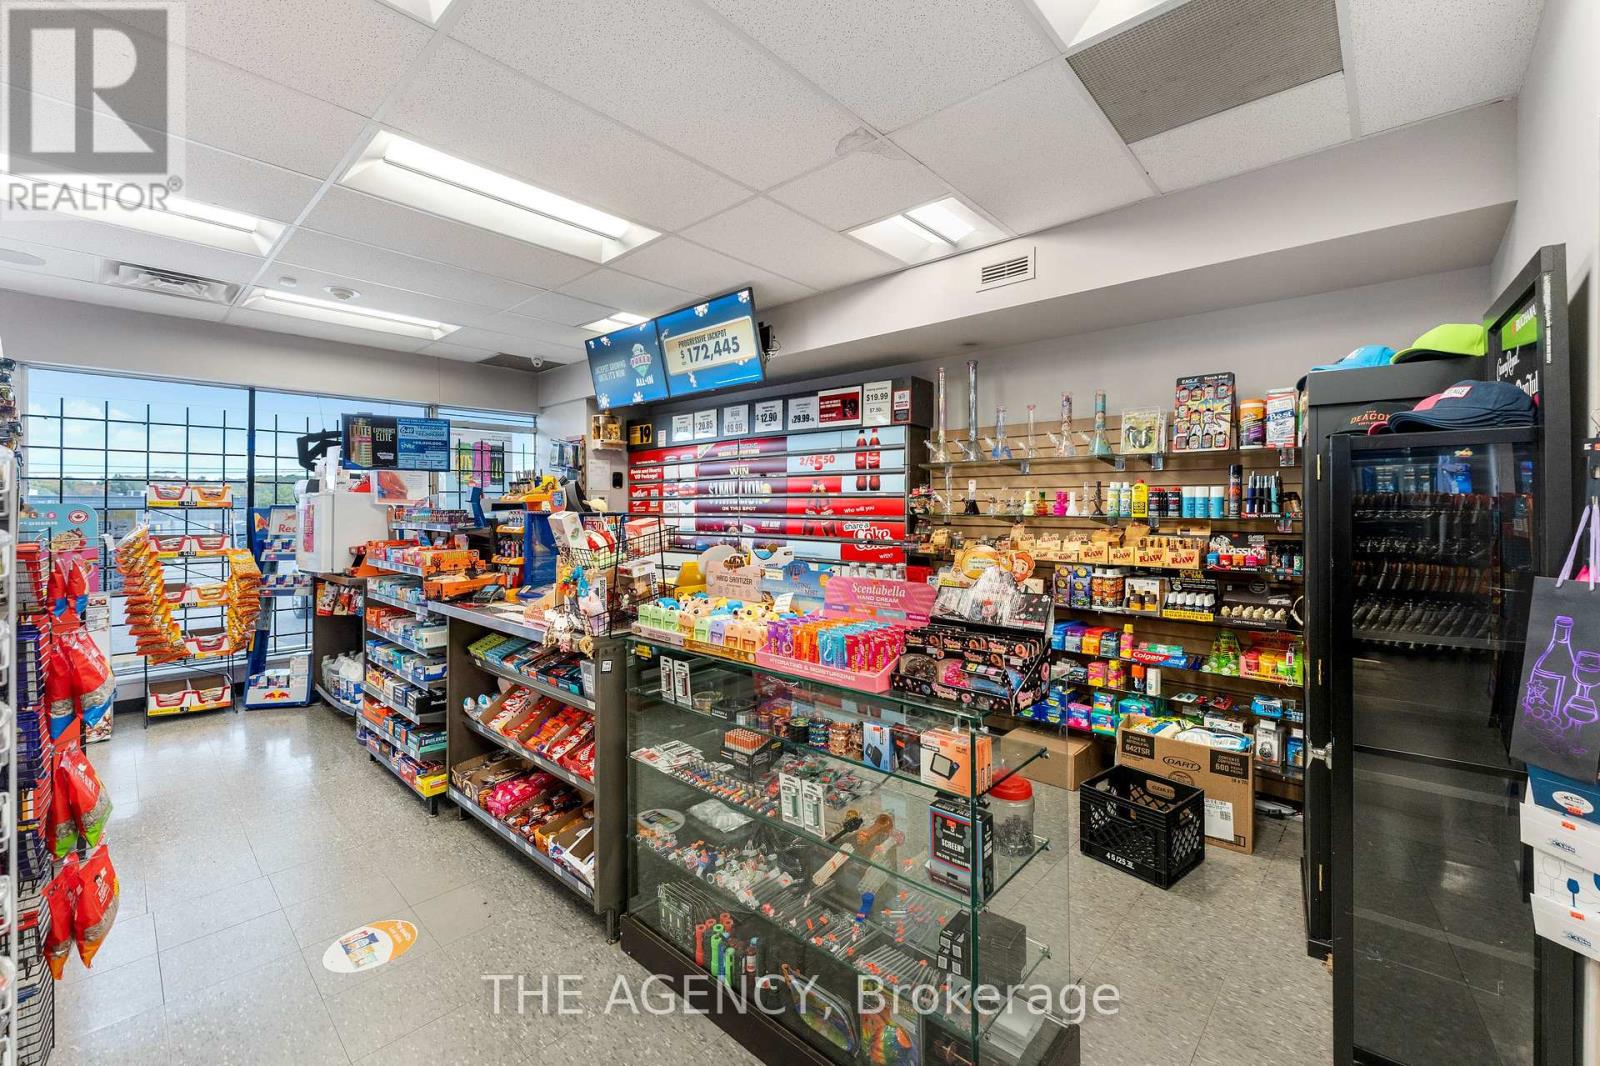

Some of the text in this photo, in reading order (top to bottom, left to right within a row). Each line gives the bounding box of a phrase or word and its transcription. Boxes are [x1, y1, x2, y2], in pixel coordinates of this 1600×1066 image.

[678, 329, 728, 348] PROGRESSIVE JACKPOT
[687, 336, 740, 363] 172,445
[866, 392, 889, 402] $19.99
[376, 433, 392, 442] ELITE
[865, 505, 875, 513] you
[844, 522, 864, 531] share
[1083, 550, 1104, 558] RAW
[1139, 554, 1163, 563] RAW
[1171, 555, 1195, 564] RAW
[729, 575, 753, 585] SANITIZER
[852, 582, 906, 598] Scentabella
[857, 594, 899, 604] HAND CREAM
[1133, 651, 1166, 661] Colgate
[769, 657, 803, 671] HYDRATING
[809, 667, 856, 681] MOISTURIZING
[1167, 758, 1196, 769] DART
[941, 838, 965, 853] SCREENS
